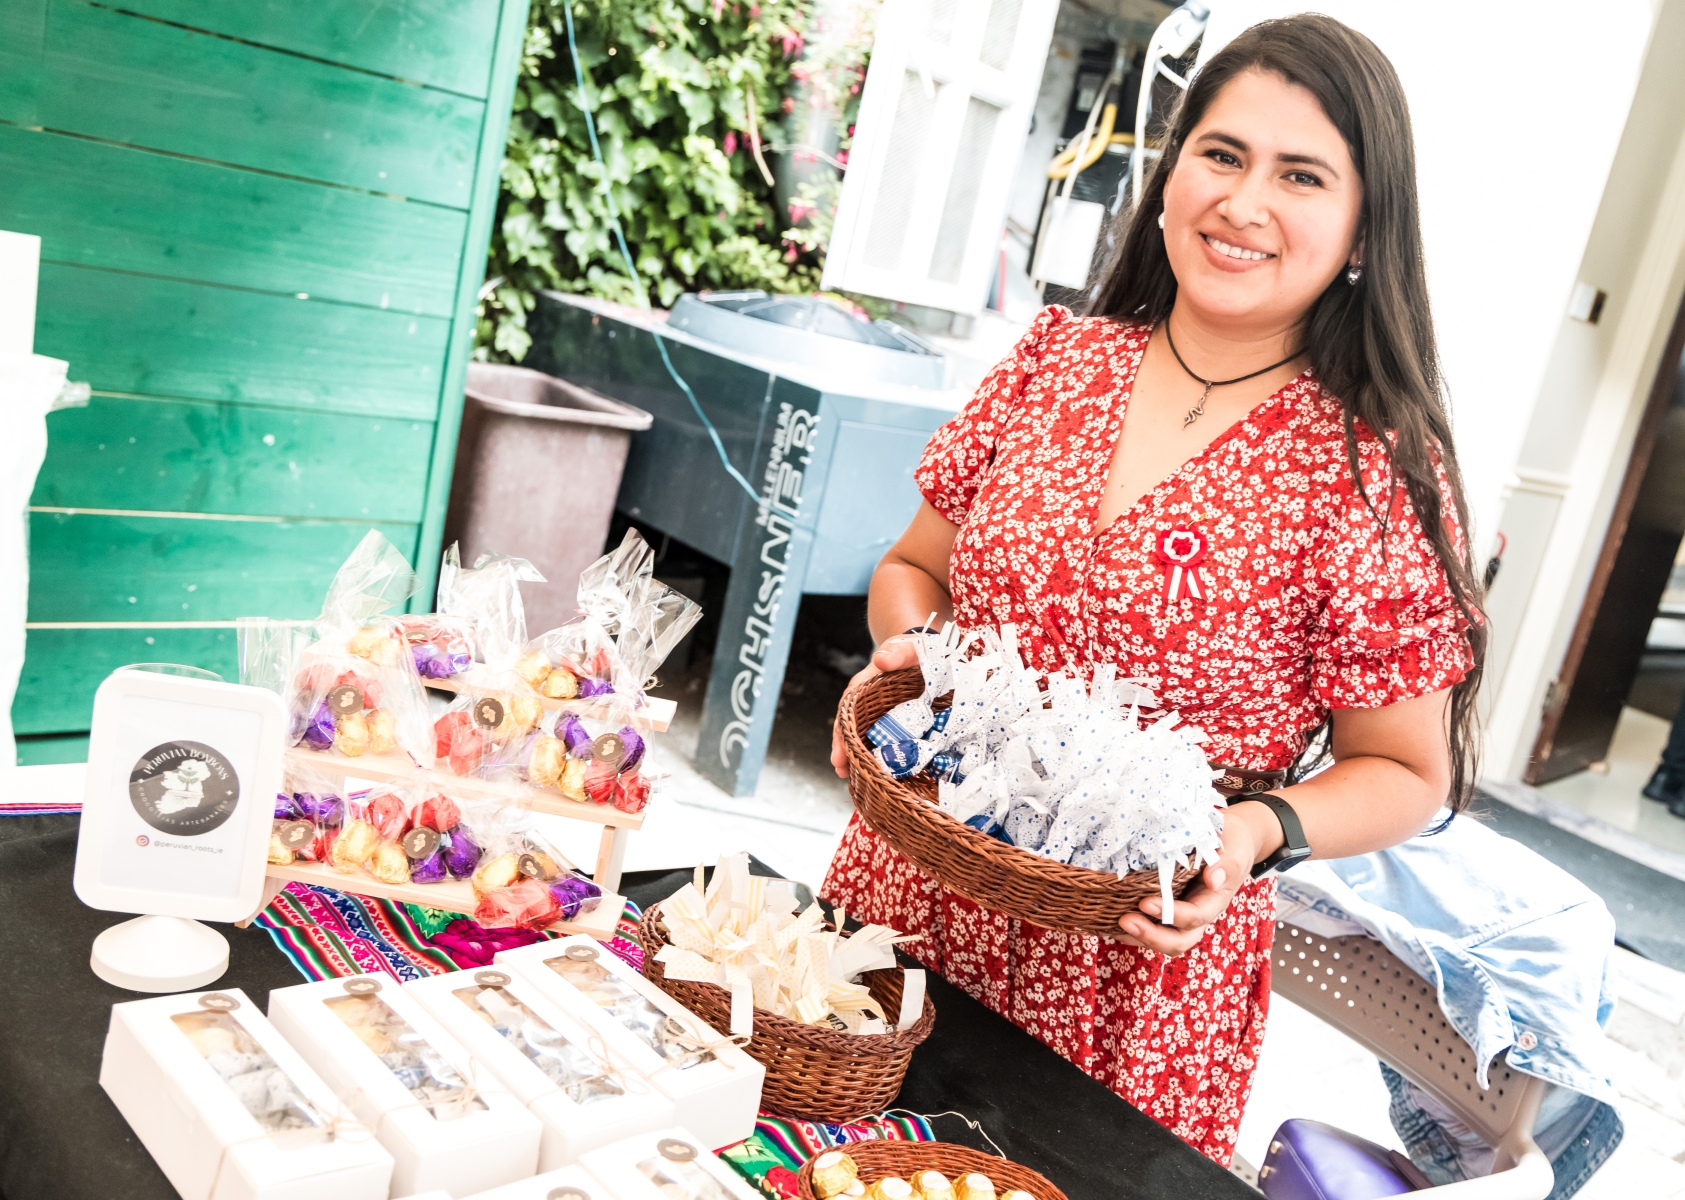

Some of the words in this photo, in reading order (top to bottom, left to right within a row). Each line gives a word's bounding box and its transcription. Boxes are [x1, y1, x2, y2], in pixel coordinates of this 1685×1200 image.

[755, 401, 794, 528] MILLENNIUM
[143, 748, 188, 775] PERUVIAN
[189, 749, 229, 780] BONBONS
[153, 840, 224, 854] @peruvian_roots_ie
